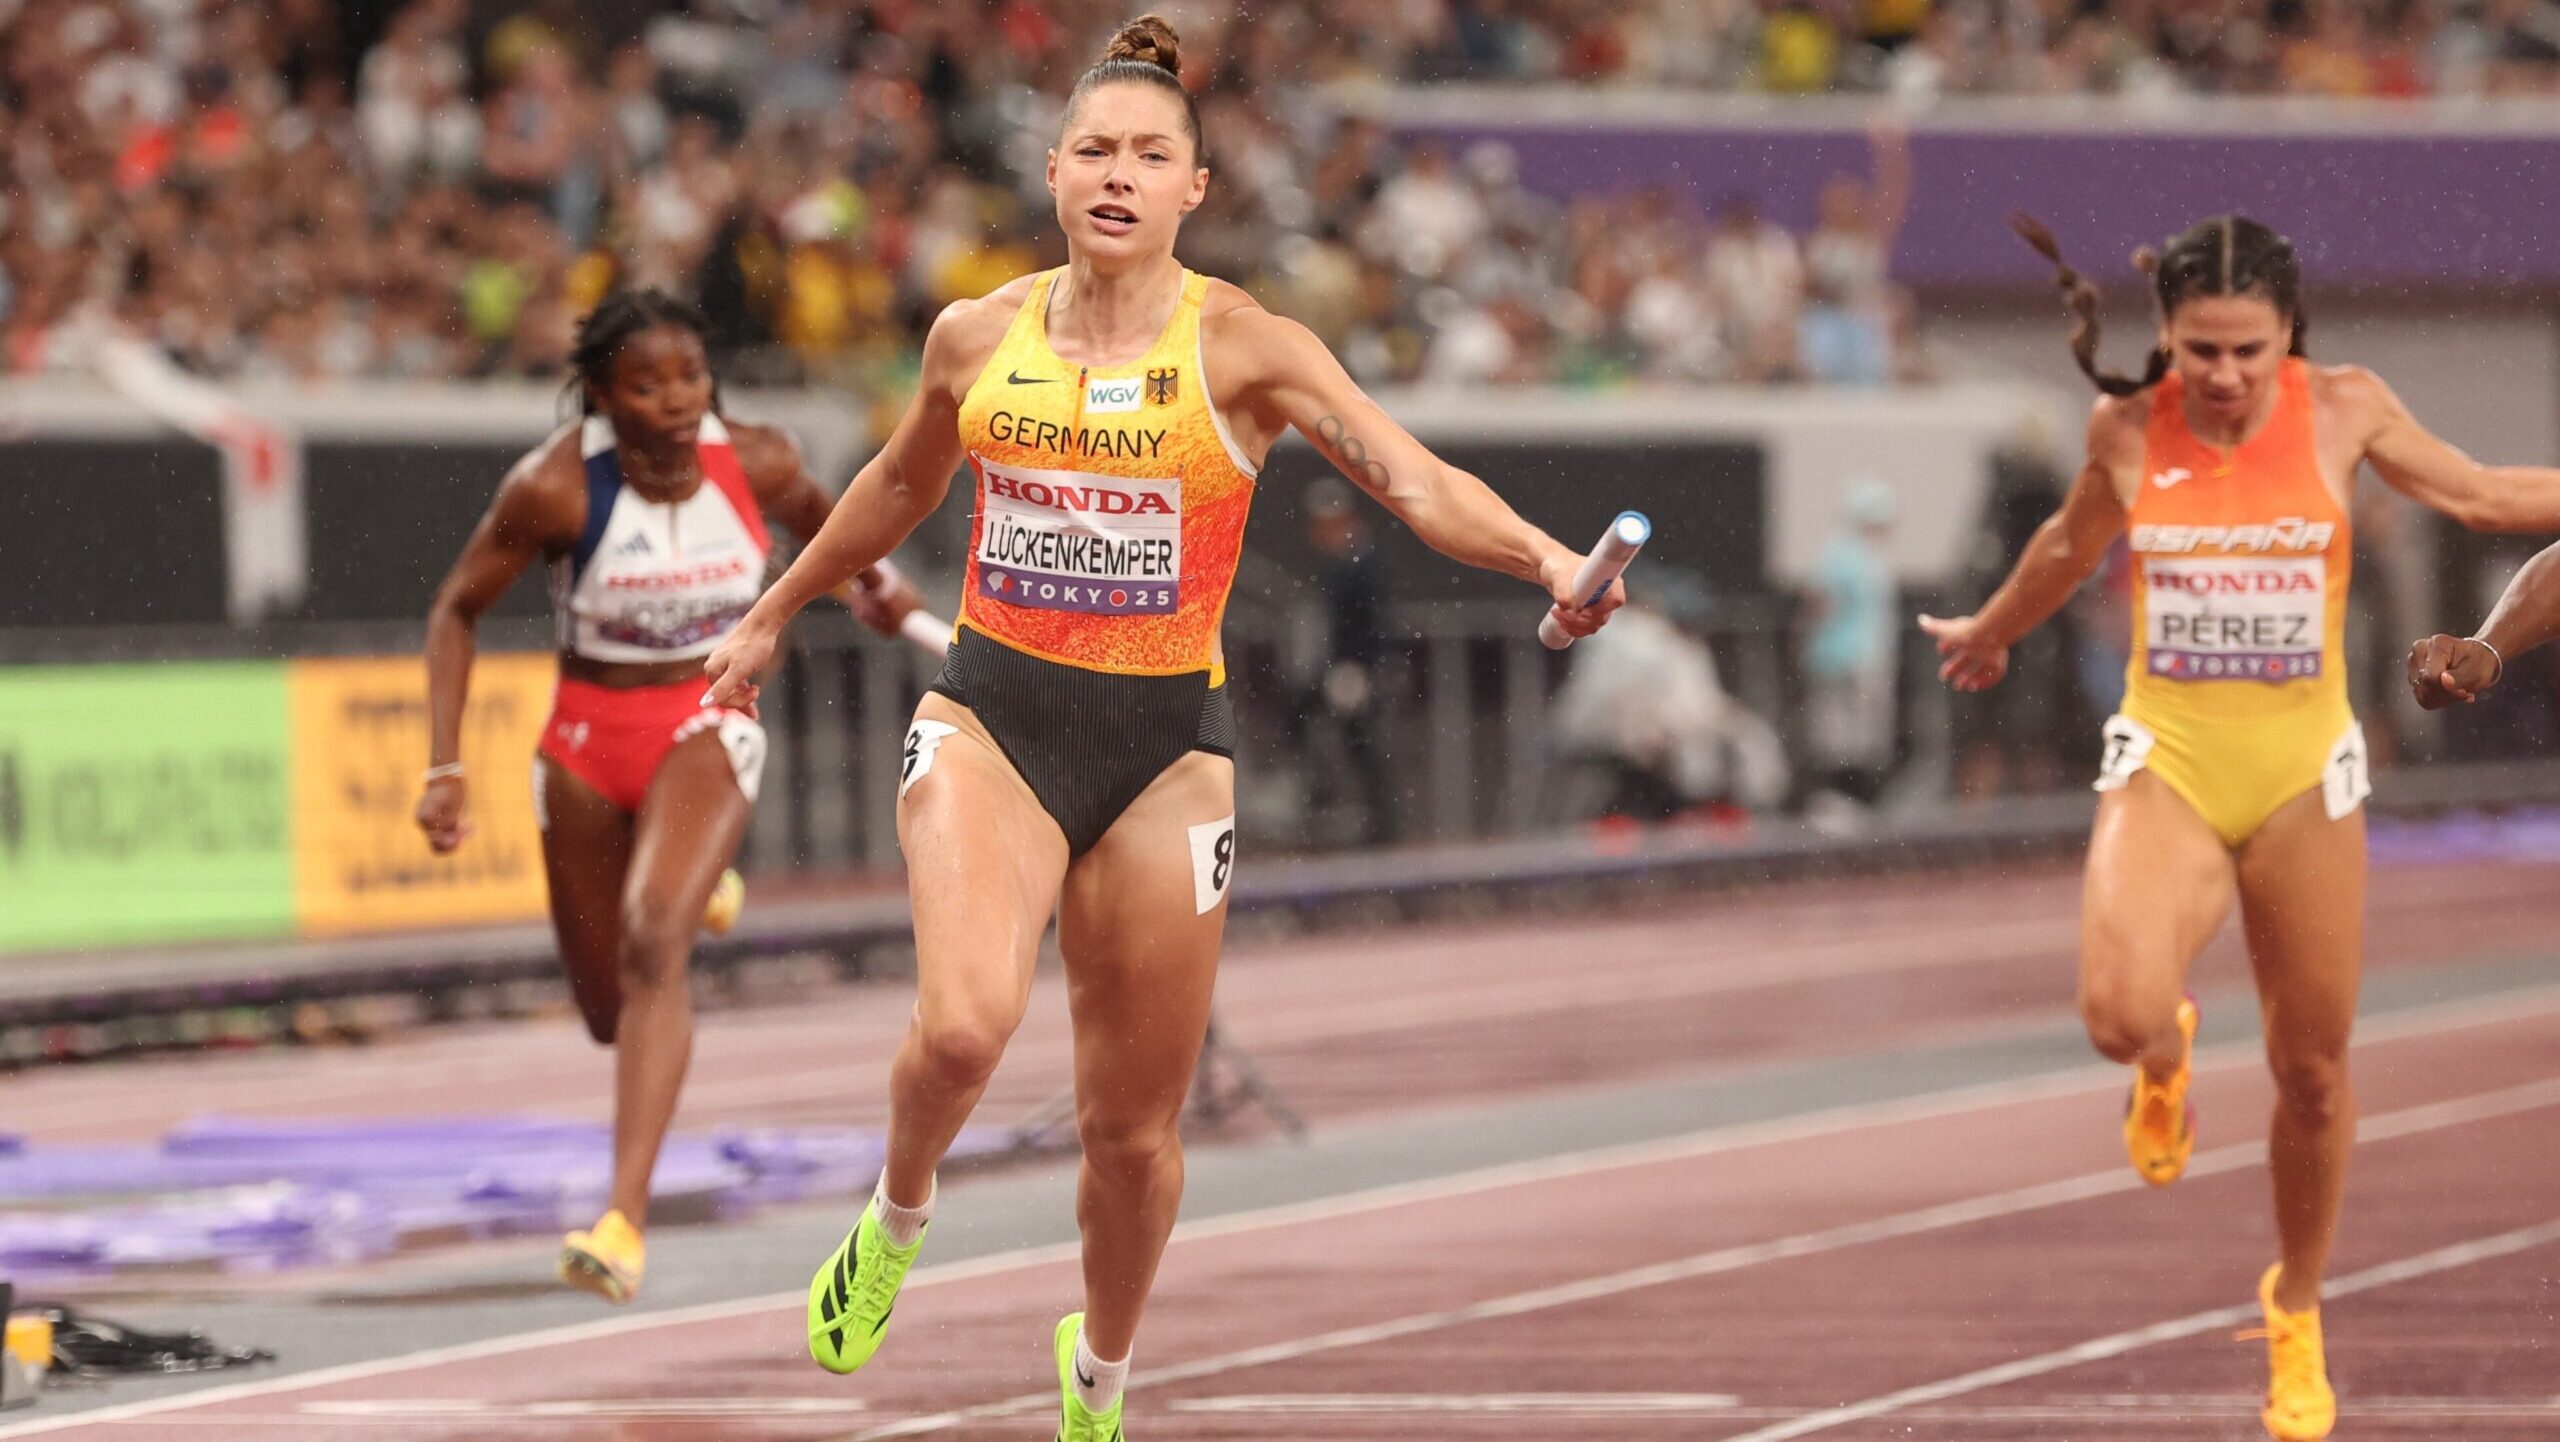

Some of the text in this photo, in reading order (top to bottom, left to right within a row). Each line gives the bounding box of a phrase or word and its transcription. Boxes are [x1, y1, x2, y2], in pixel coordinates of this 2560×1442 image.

[1090, 385, 1140, 405] WGV
[989, 411, 1167, 459] GERMANY
[986, 472, 1176, 515] HONDA
[986, 515, 1173, 576] LÜCKENKEMPER
[2131, 516, 2336, 553] ESPAÑA
[2152, 570, 2317, 596] HONDA
[2161, 603, 2309, 646] PÉREZ
[1212, 828, 1233, 892] 8
